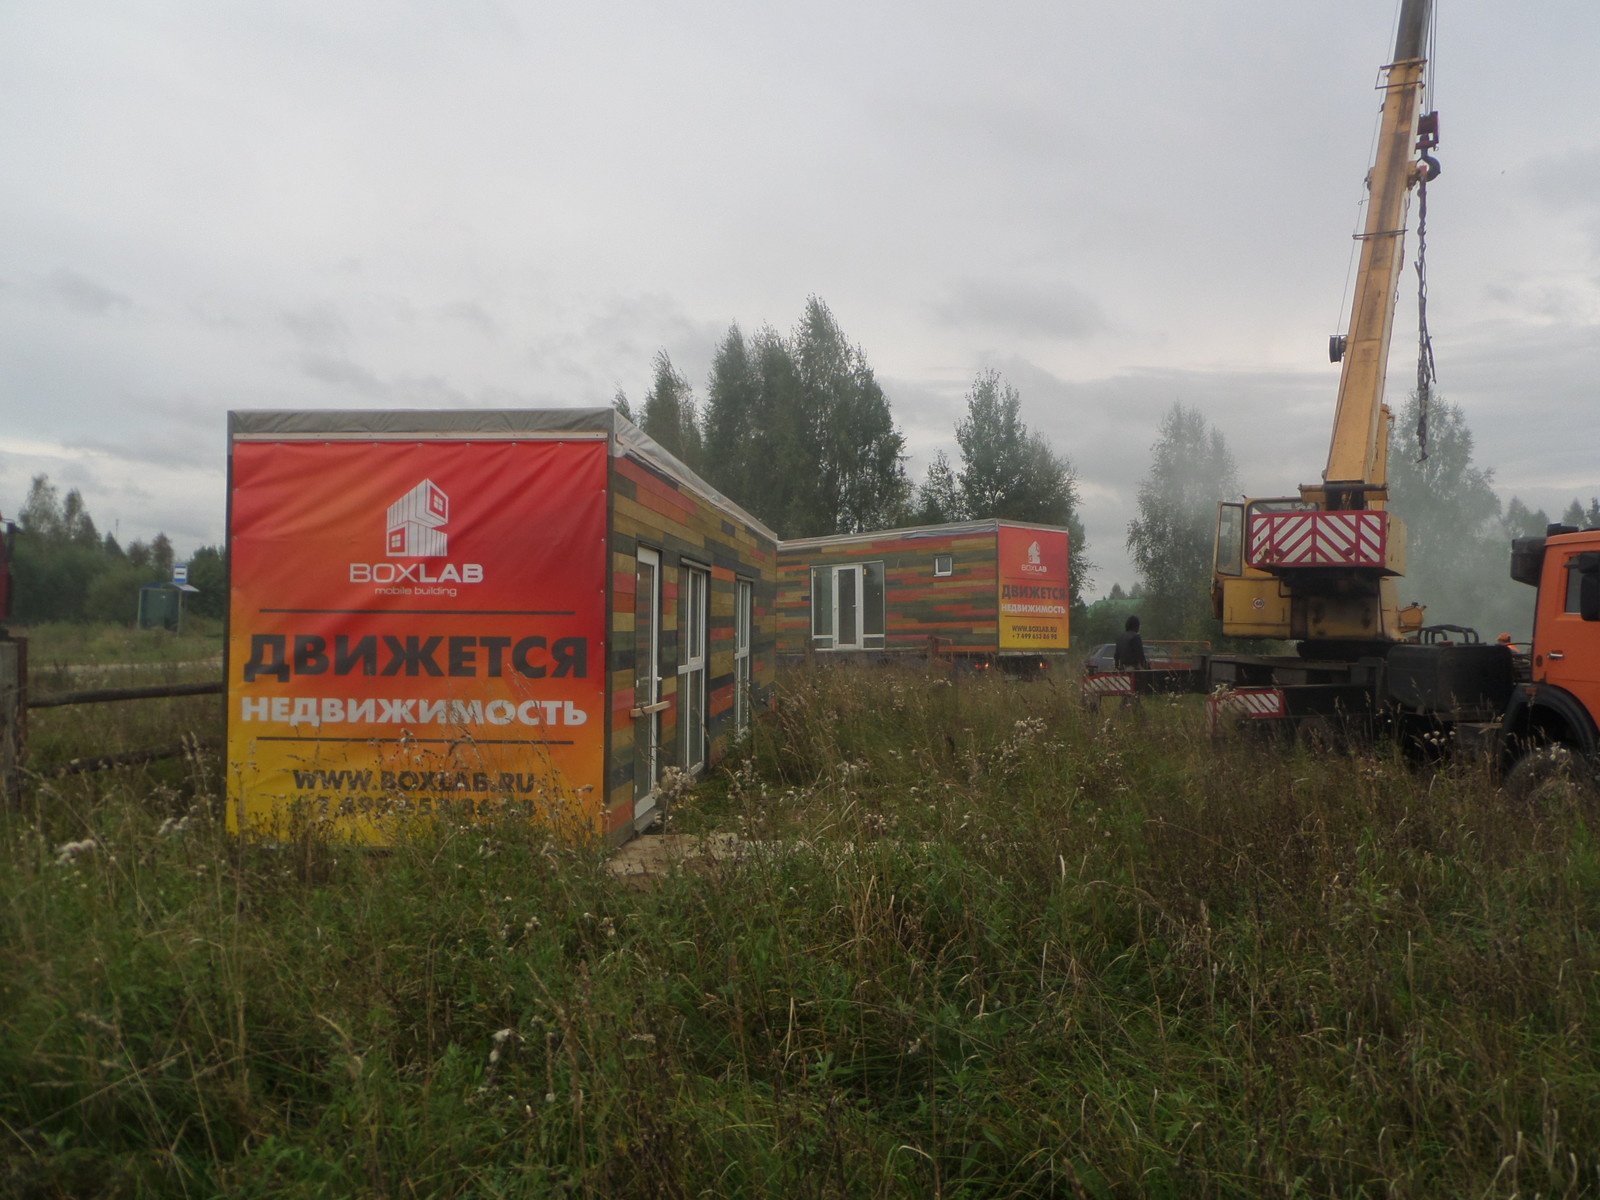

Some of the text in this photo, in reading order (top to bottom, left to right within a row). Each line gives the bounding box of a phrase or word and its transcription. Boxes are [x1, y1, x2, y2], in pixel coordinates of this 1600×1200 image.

[349, 563, 484, 583] BOXLAB
[1021, 564, 1047, 573] BOXLAB
[375, 586, 457, 597] mobile building
[1002, 585, 1066, 600] ДВИЖЕТСЯ
[1001, 603, 1066, 614] НЕДВИЖИМОСТЬ
[243, 634, 588, 683] ДВИЖЕТСЯ
[241, 697, 588, 726] НЕДВИЖИМОСТЬ
[293, 769, 535, 793] WWW.BOXLAB.RU
